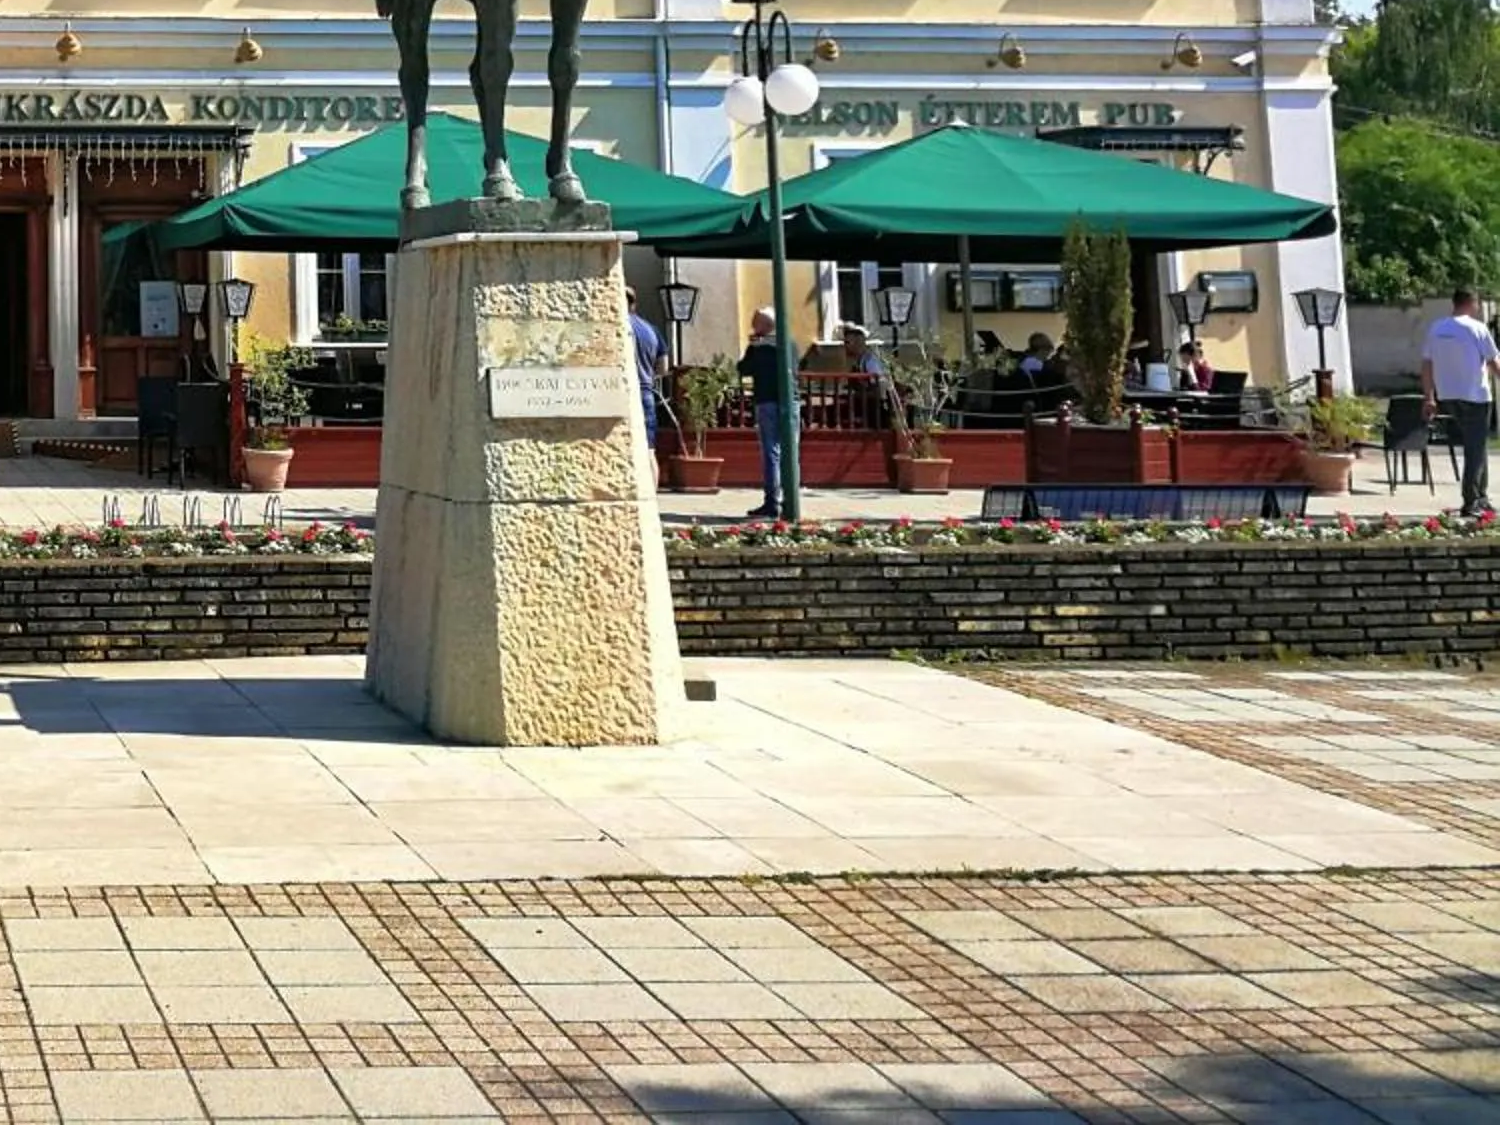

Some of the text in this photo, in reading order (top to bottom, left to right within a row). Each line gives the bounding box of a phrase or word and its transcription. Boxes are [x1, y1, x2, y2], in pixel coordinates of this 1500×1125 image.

[190, 95, 406, 122] KONDITORE
[774, 93, 1177, 127] LSON ÉTTEREM PUB
